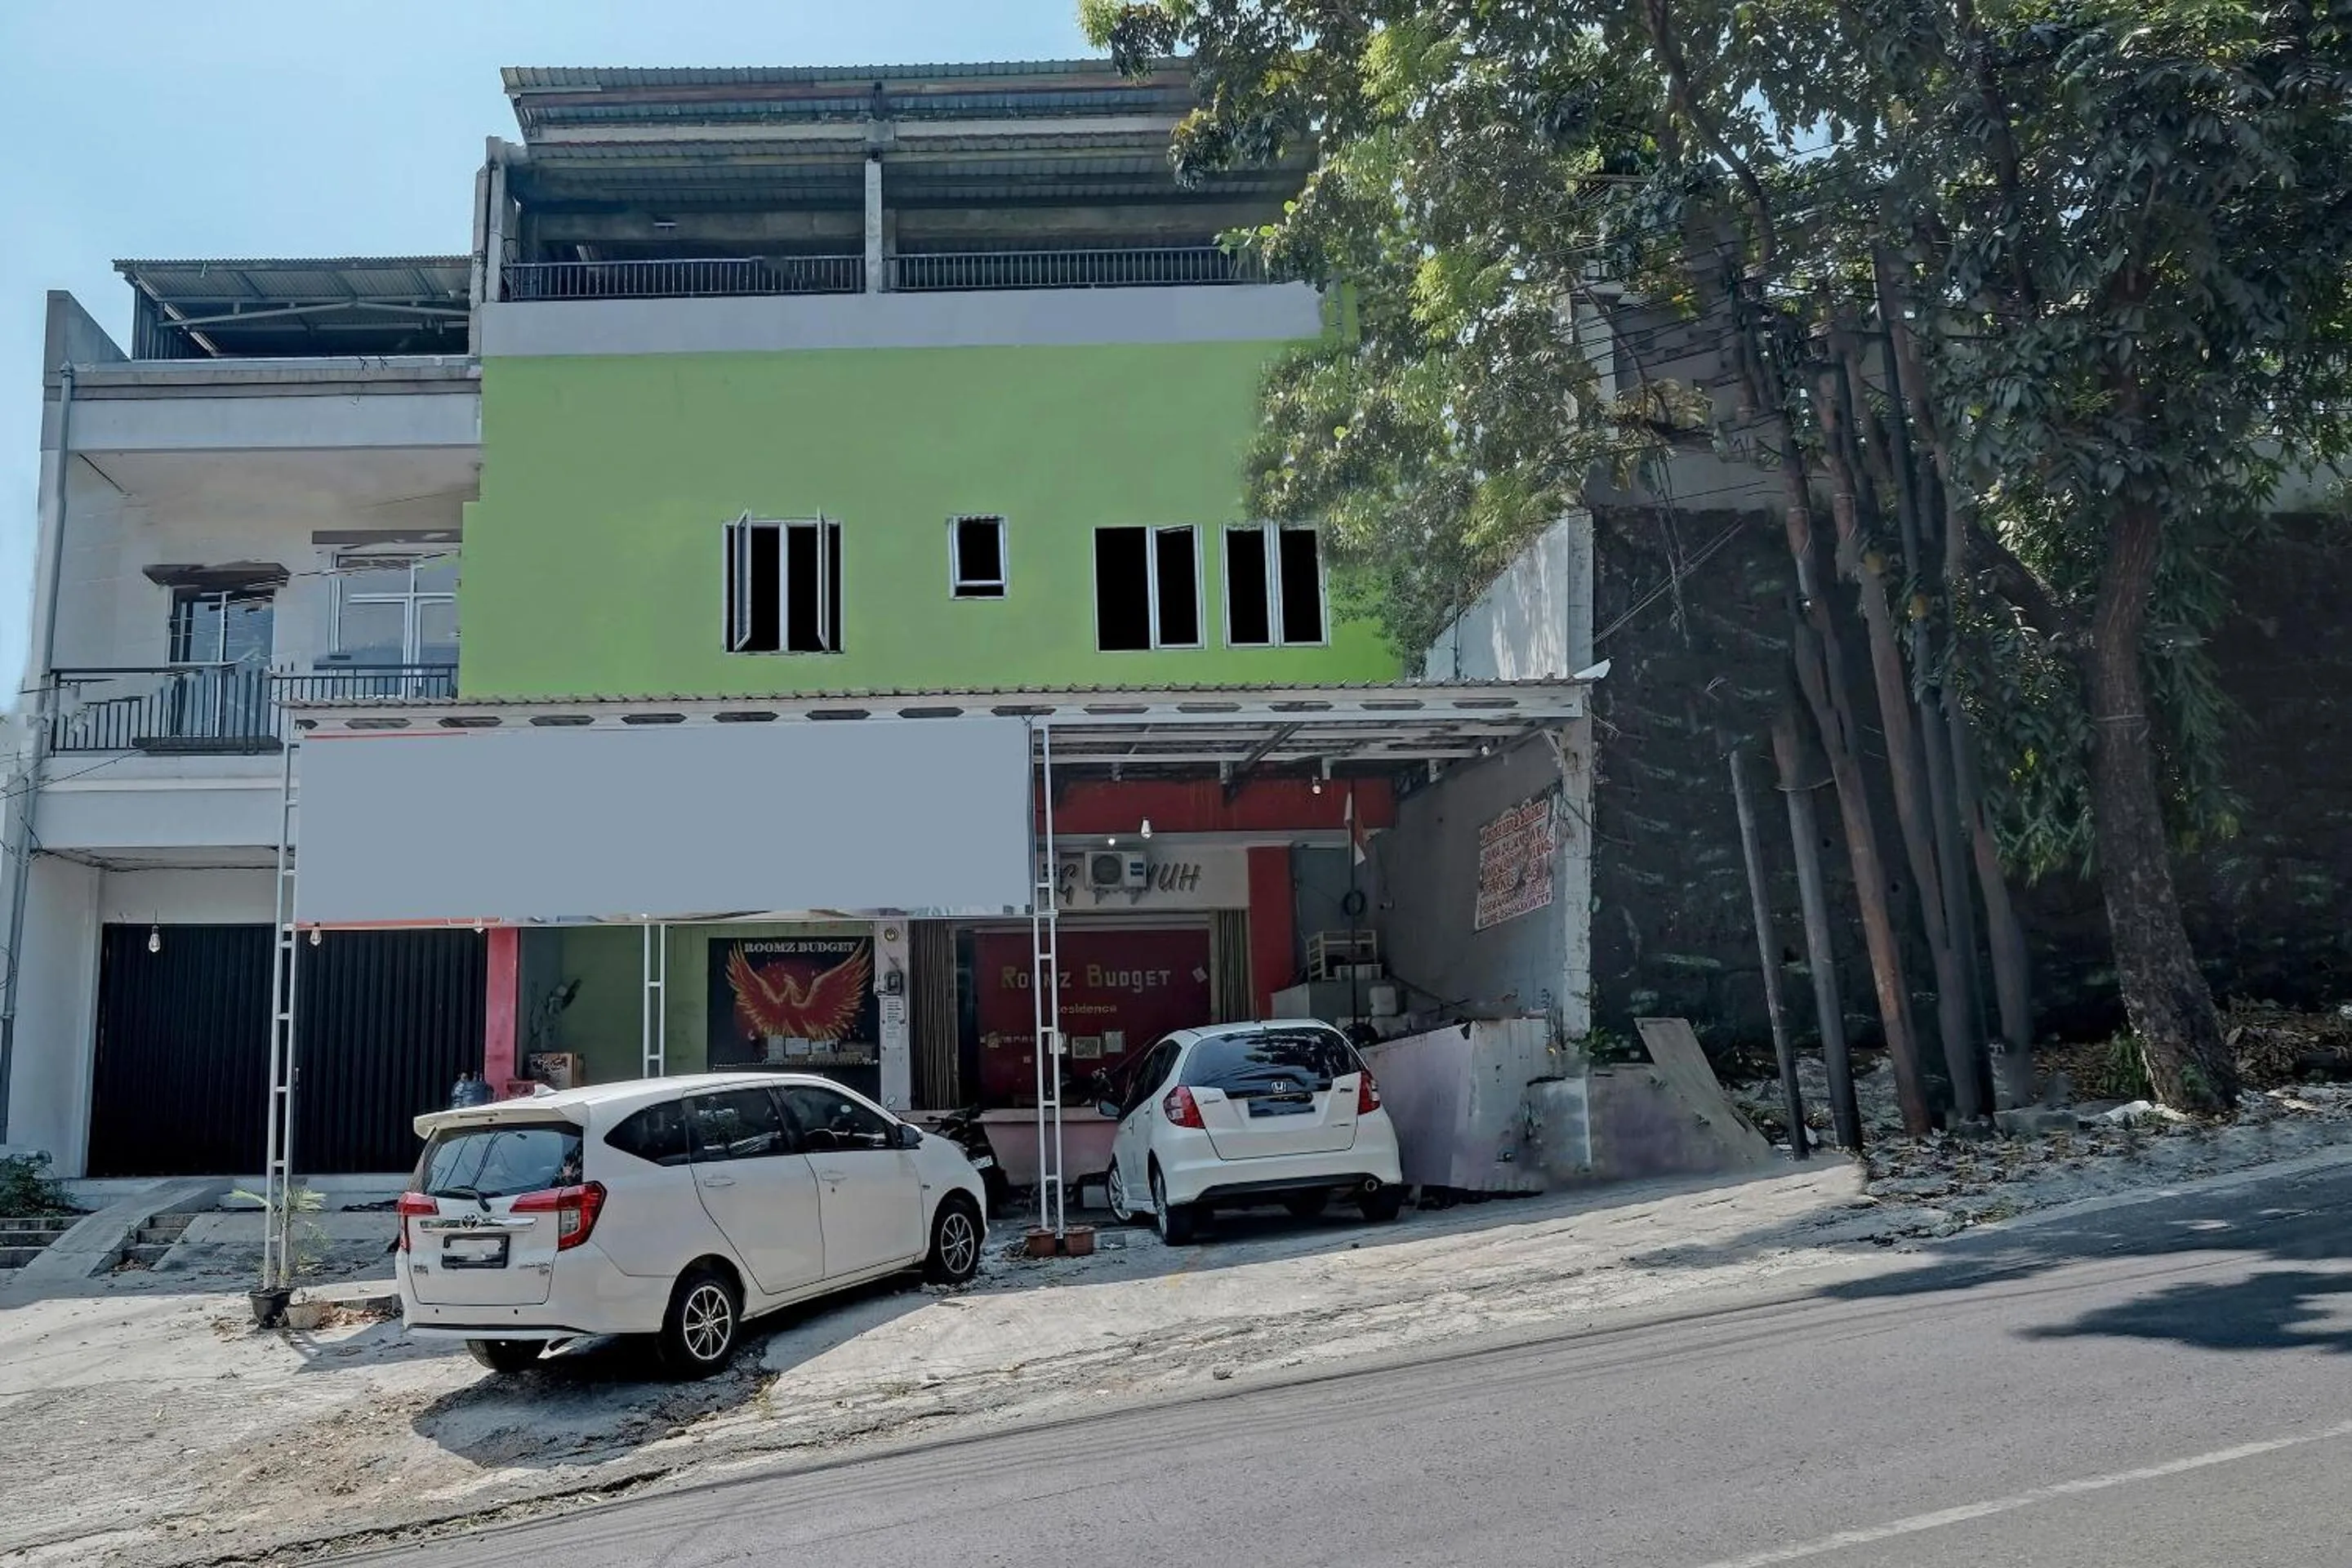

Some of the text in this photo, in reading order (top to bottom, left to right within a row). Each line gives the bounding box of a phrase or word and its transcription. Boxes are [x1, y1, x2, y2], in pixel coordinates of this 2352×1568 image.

[744, 941, 858, 953] ROOMZ BUDGET
[1057, 1003, 1118, 1014] esidence
